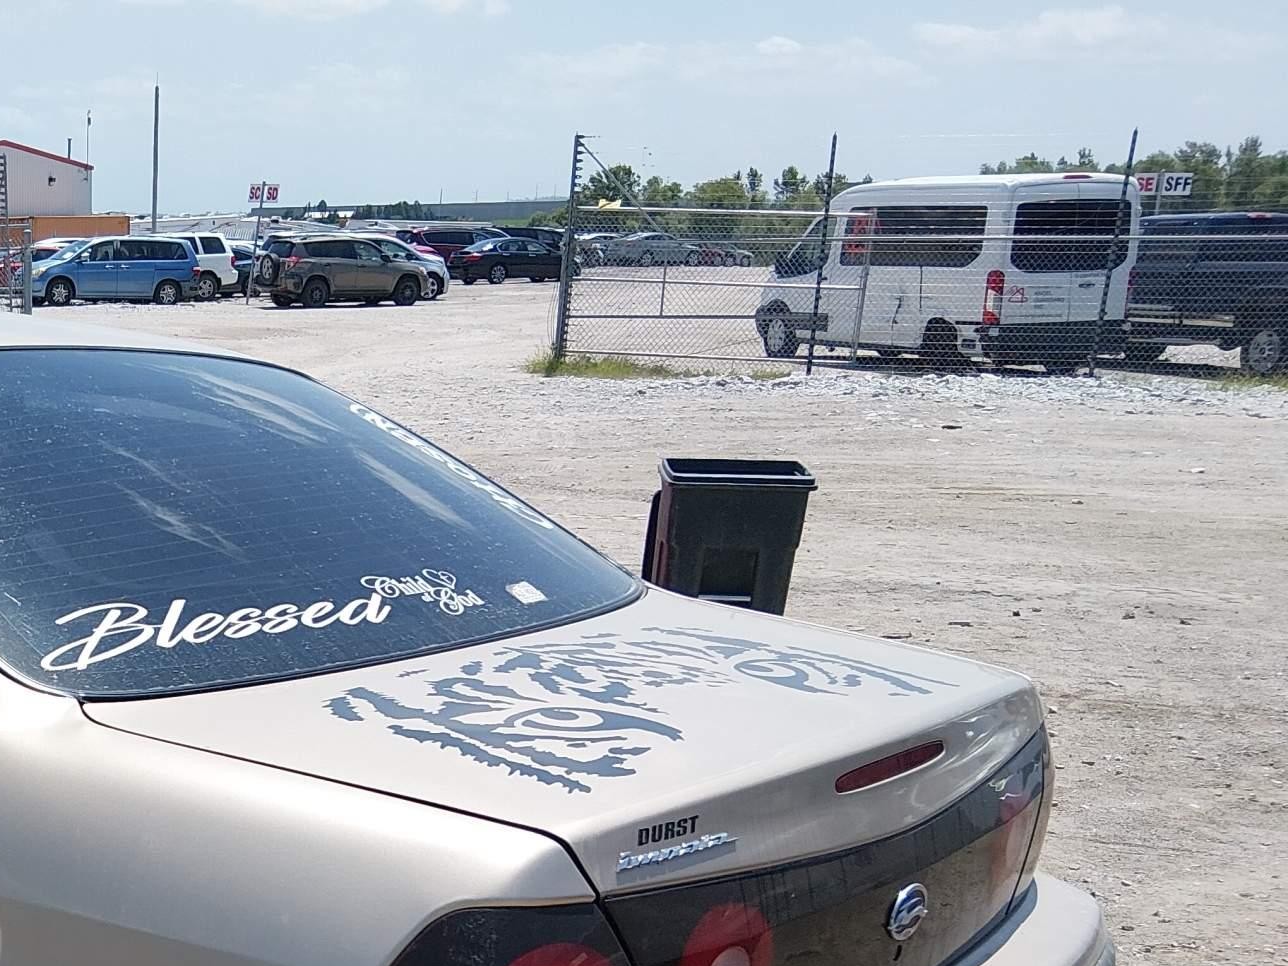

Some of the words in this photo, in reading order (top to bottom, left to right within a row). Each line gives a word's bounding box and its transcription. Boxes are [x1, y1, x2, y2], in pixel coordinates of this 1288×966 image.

[249, 186, 261, 200] SC
[266, 187, 279, 201] SD
[1165, 176, 1192, 192] SFF
[360, 575, 431, 599] Child
[430, 587, 485, 615] God
[40, 593, 393, 671] Blessed
[637, 814, 700, 847] DURST
